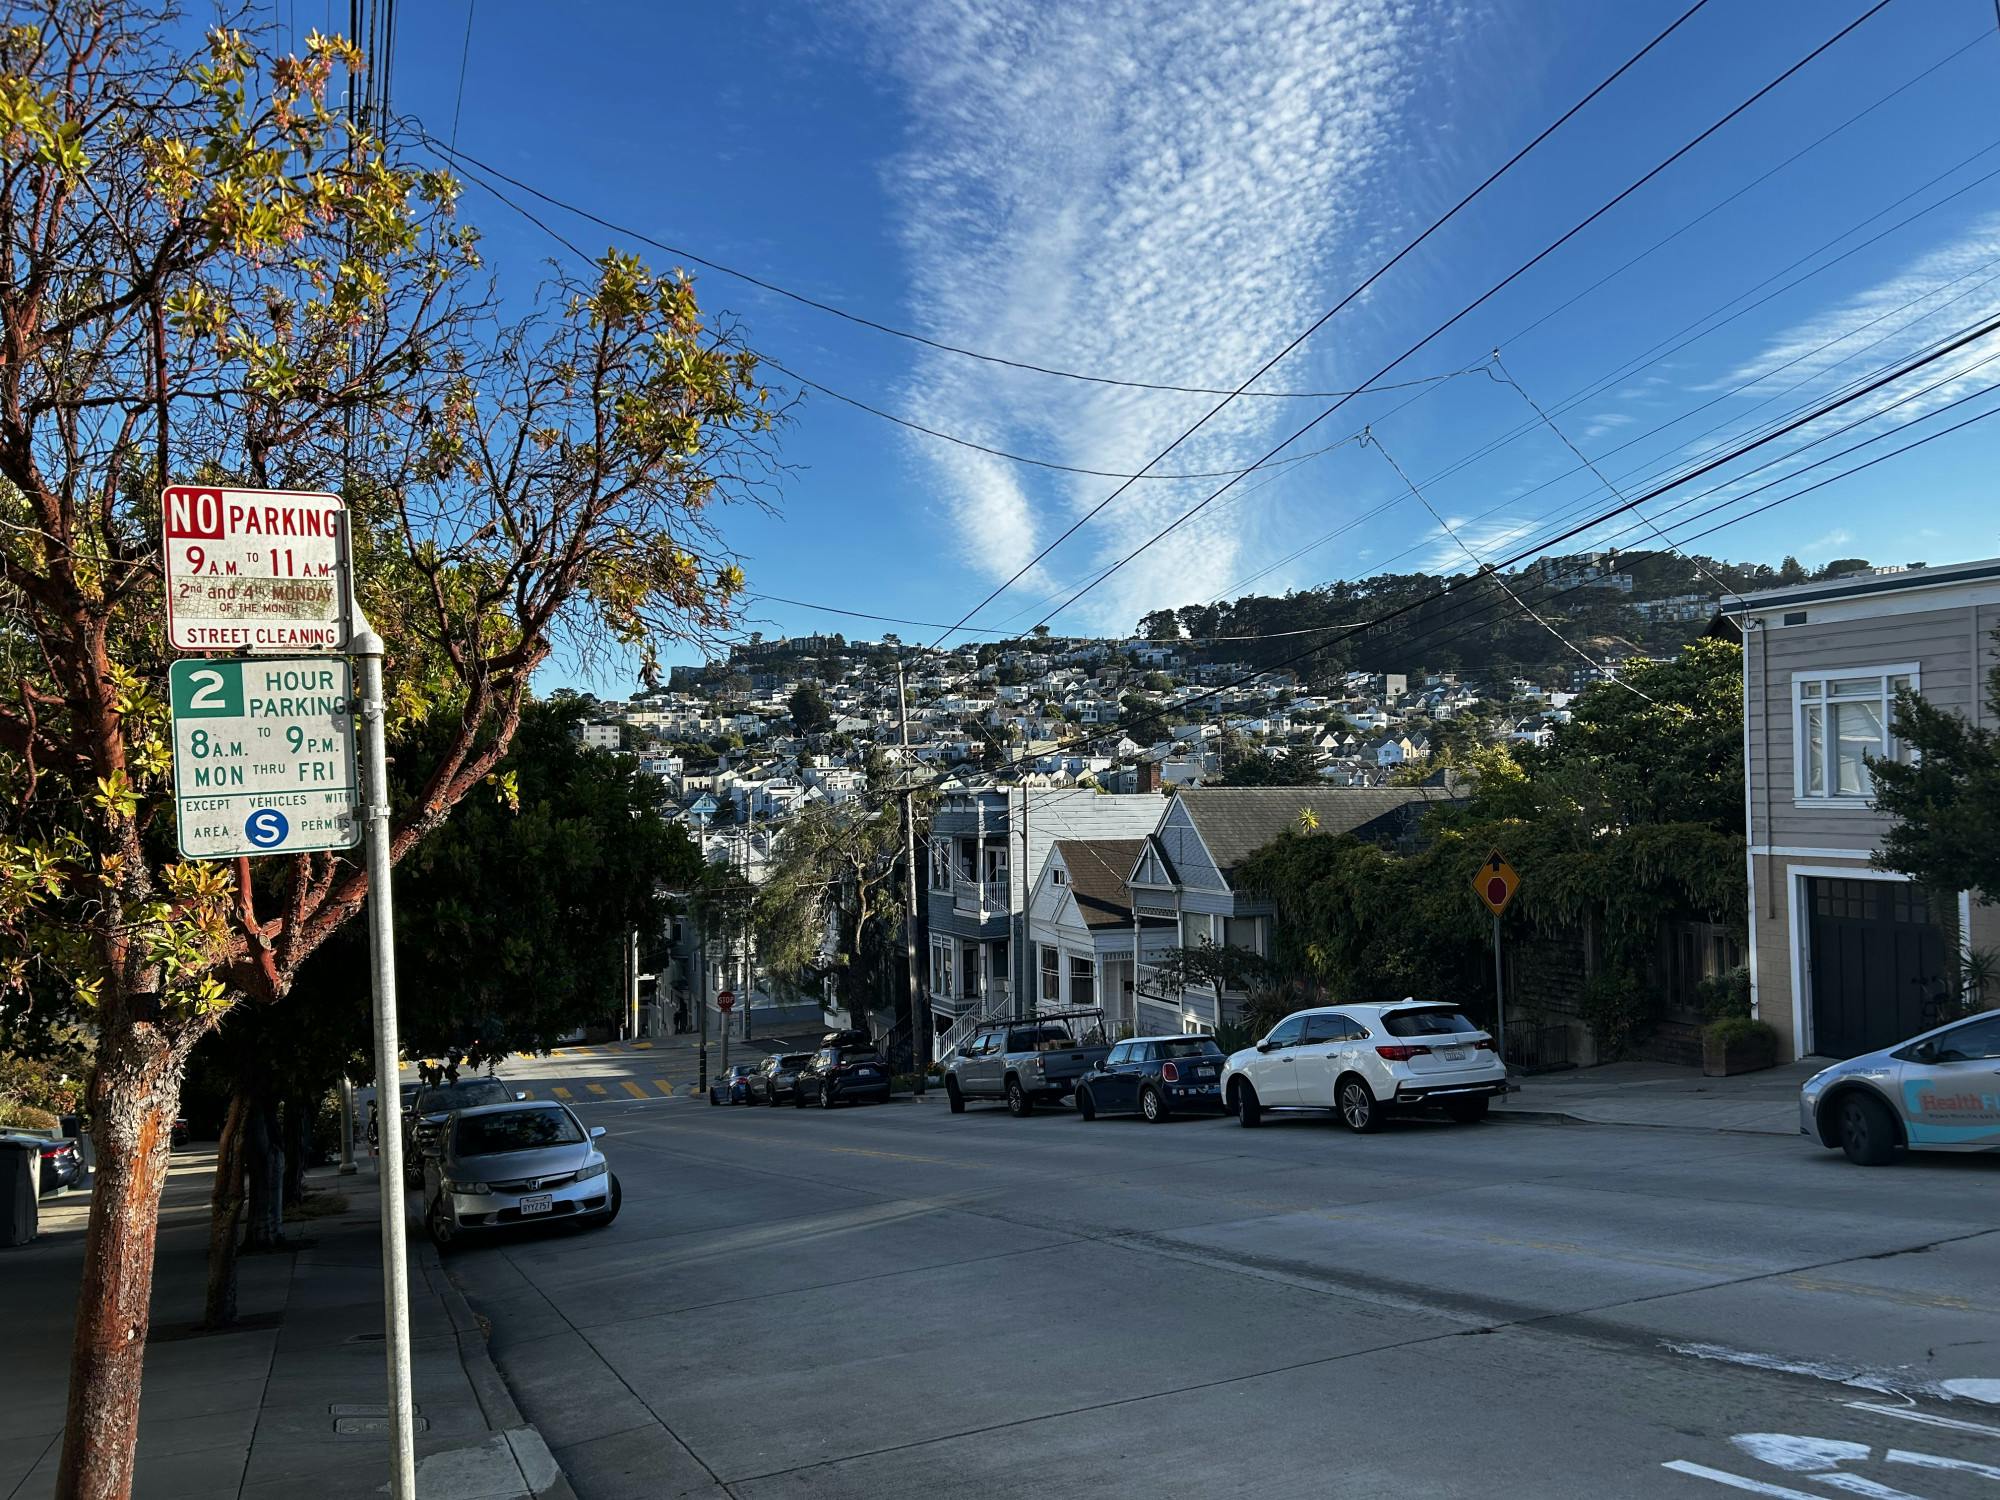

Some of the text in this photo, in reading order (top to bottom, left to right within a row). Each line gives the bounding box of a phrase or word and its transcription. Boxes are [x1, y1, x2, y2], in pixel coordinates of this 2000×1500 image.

[169, 493, 337, 538] NO PARKING
[246, 552, 259, 563] TO
[270, 548, 294, 577] 11
[179, 583, 334, 601] 2nd and 4th MONDAY
[219, 603, 299, 613] OF THE MONTH
[187, 628, 335, 644] STREET CLEANING
[188, 669, 334, 709] 2 HOUR
[250, 696, 346, 717] PARKING
[257, 727, 271, 738] TO
[194, 761, 334, 787] MON THRU FRI
[186, 792, 350, 812] EXCEPT VEHICLES WITH
[194, 814, 350, 844] AREA S PERMITS
